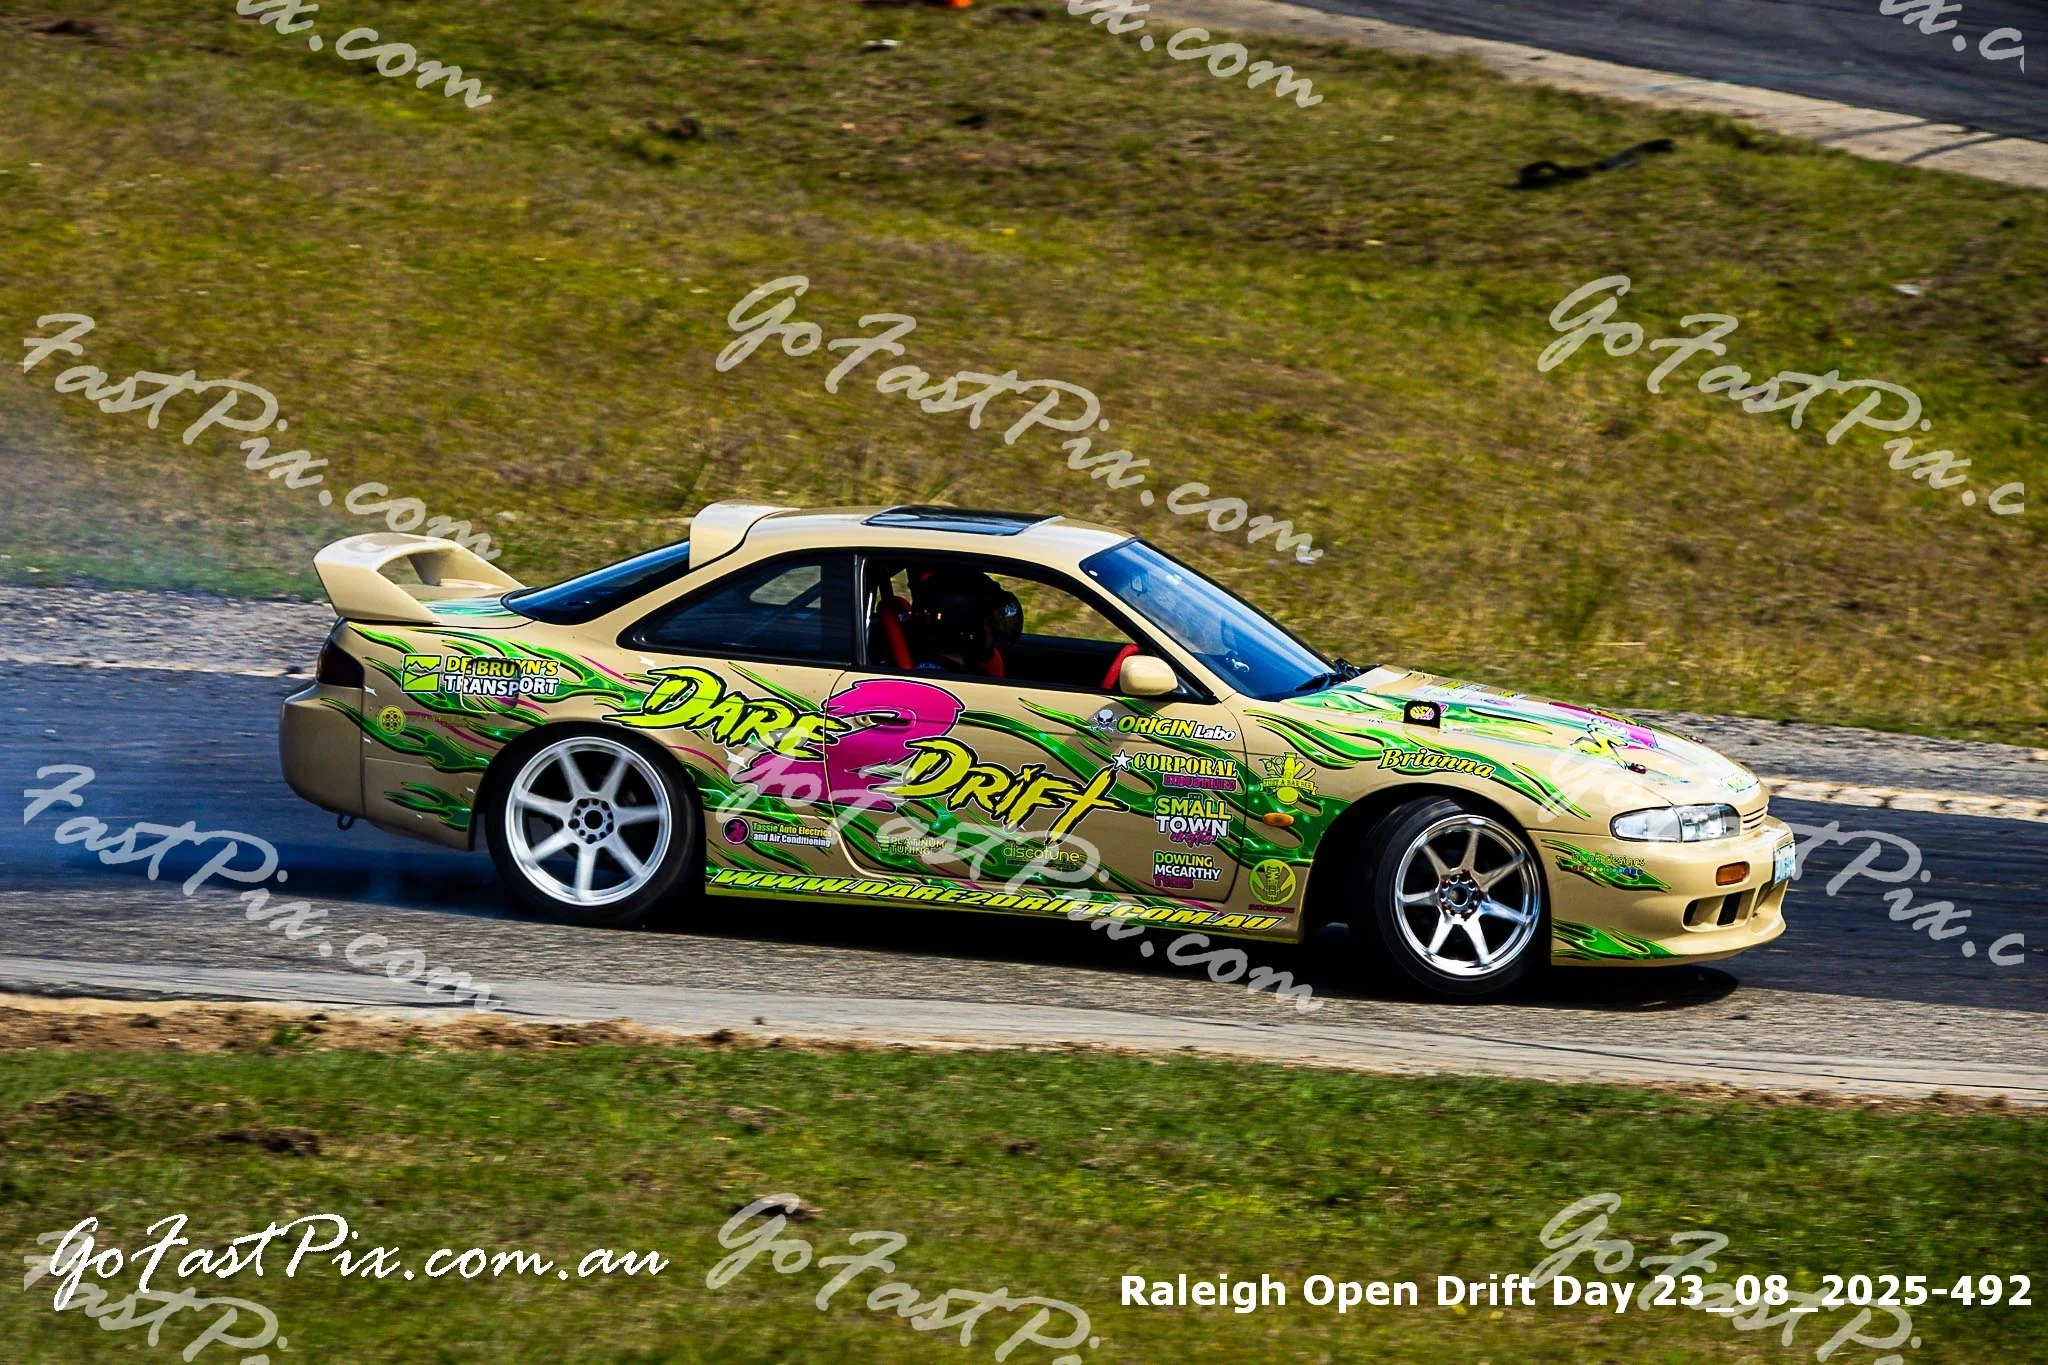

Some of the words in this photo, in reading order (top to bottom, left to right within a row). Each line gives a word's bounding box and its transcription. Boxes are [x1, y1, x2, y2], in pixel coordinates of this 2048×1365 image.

[445, 656, 474, 673] DE
[444, 675, 559, 697] TRANSPORT
[1118, 715, 1194, 737] ORIGIN
[1195, 726, 1235, 741] Labo
[1132, 752, 1238, 777] CORPORAL
[1378, 748, 1495, 779] Brianna
[1156, 796, 1232, 820] SMALL
[752, 822, 778, 832] Tassie
[779, 824, 797, 833] Auto
[798, 827, 832, 837] Electrics
[1155, 815, 1228, 837] TOWN
[753, 833, 768, 841] and
[769, 833, 781, 842] Air
[782, 834, 831, 847] Conditioning
[890, 836, 946, 848] PLATINUM
[890, 845, 932, 855] TUNING
[1003, 844, 1080, 862] discotune
[1155, 852, 1213, 867] DOWLING
[712, 869, 1284, 930] WWW.DARE2DRIFT.COM.AU
